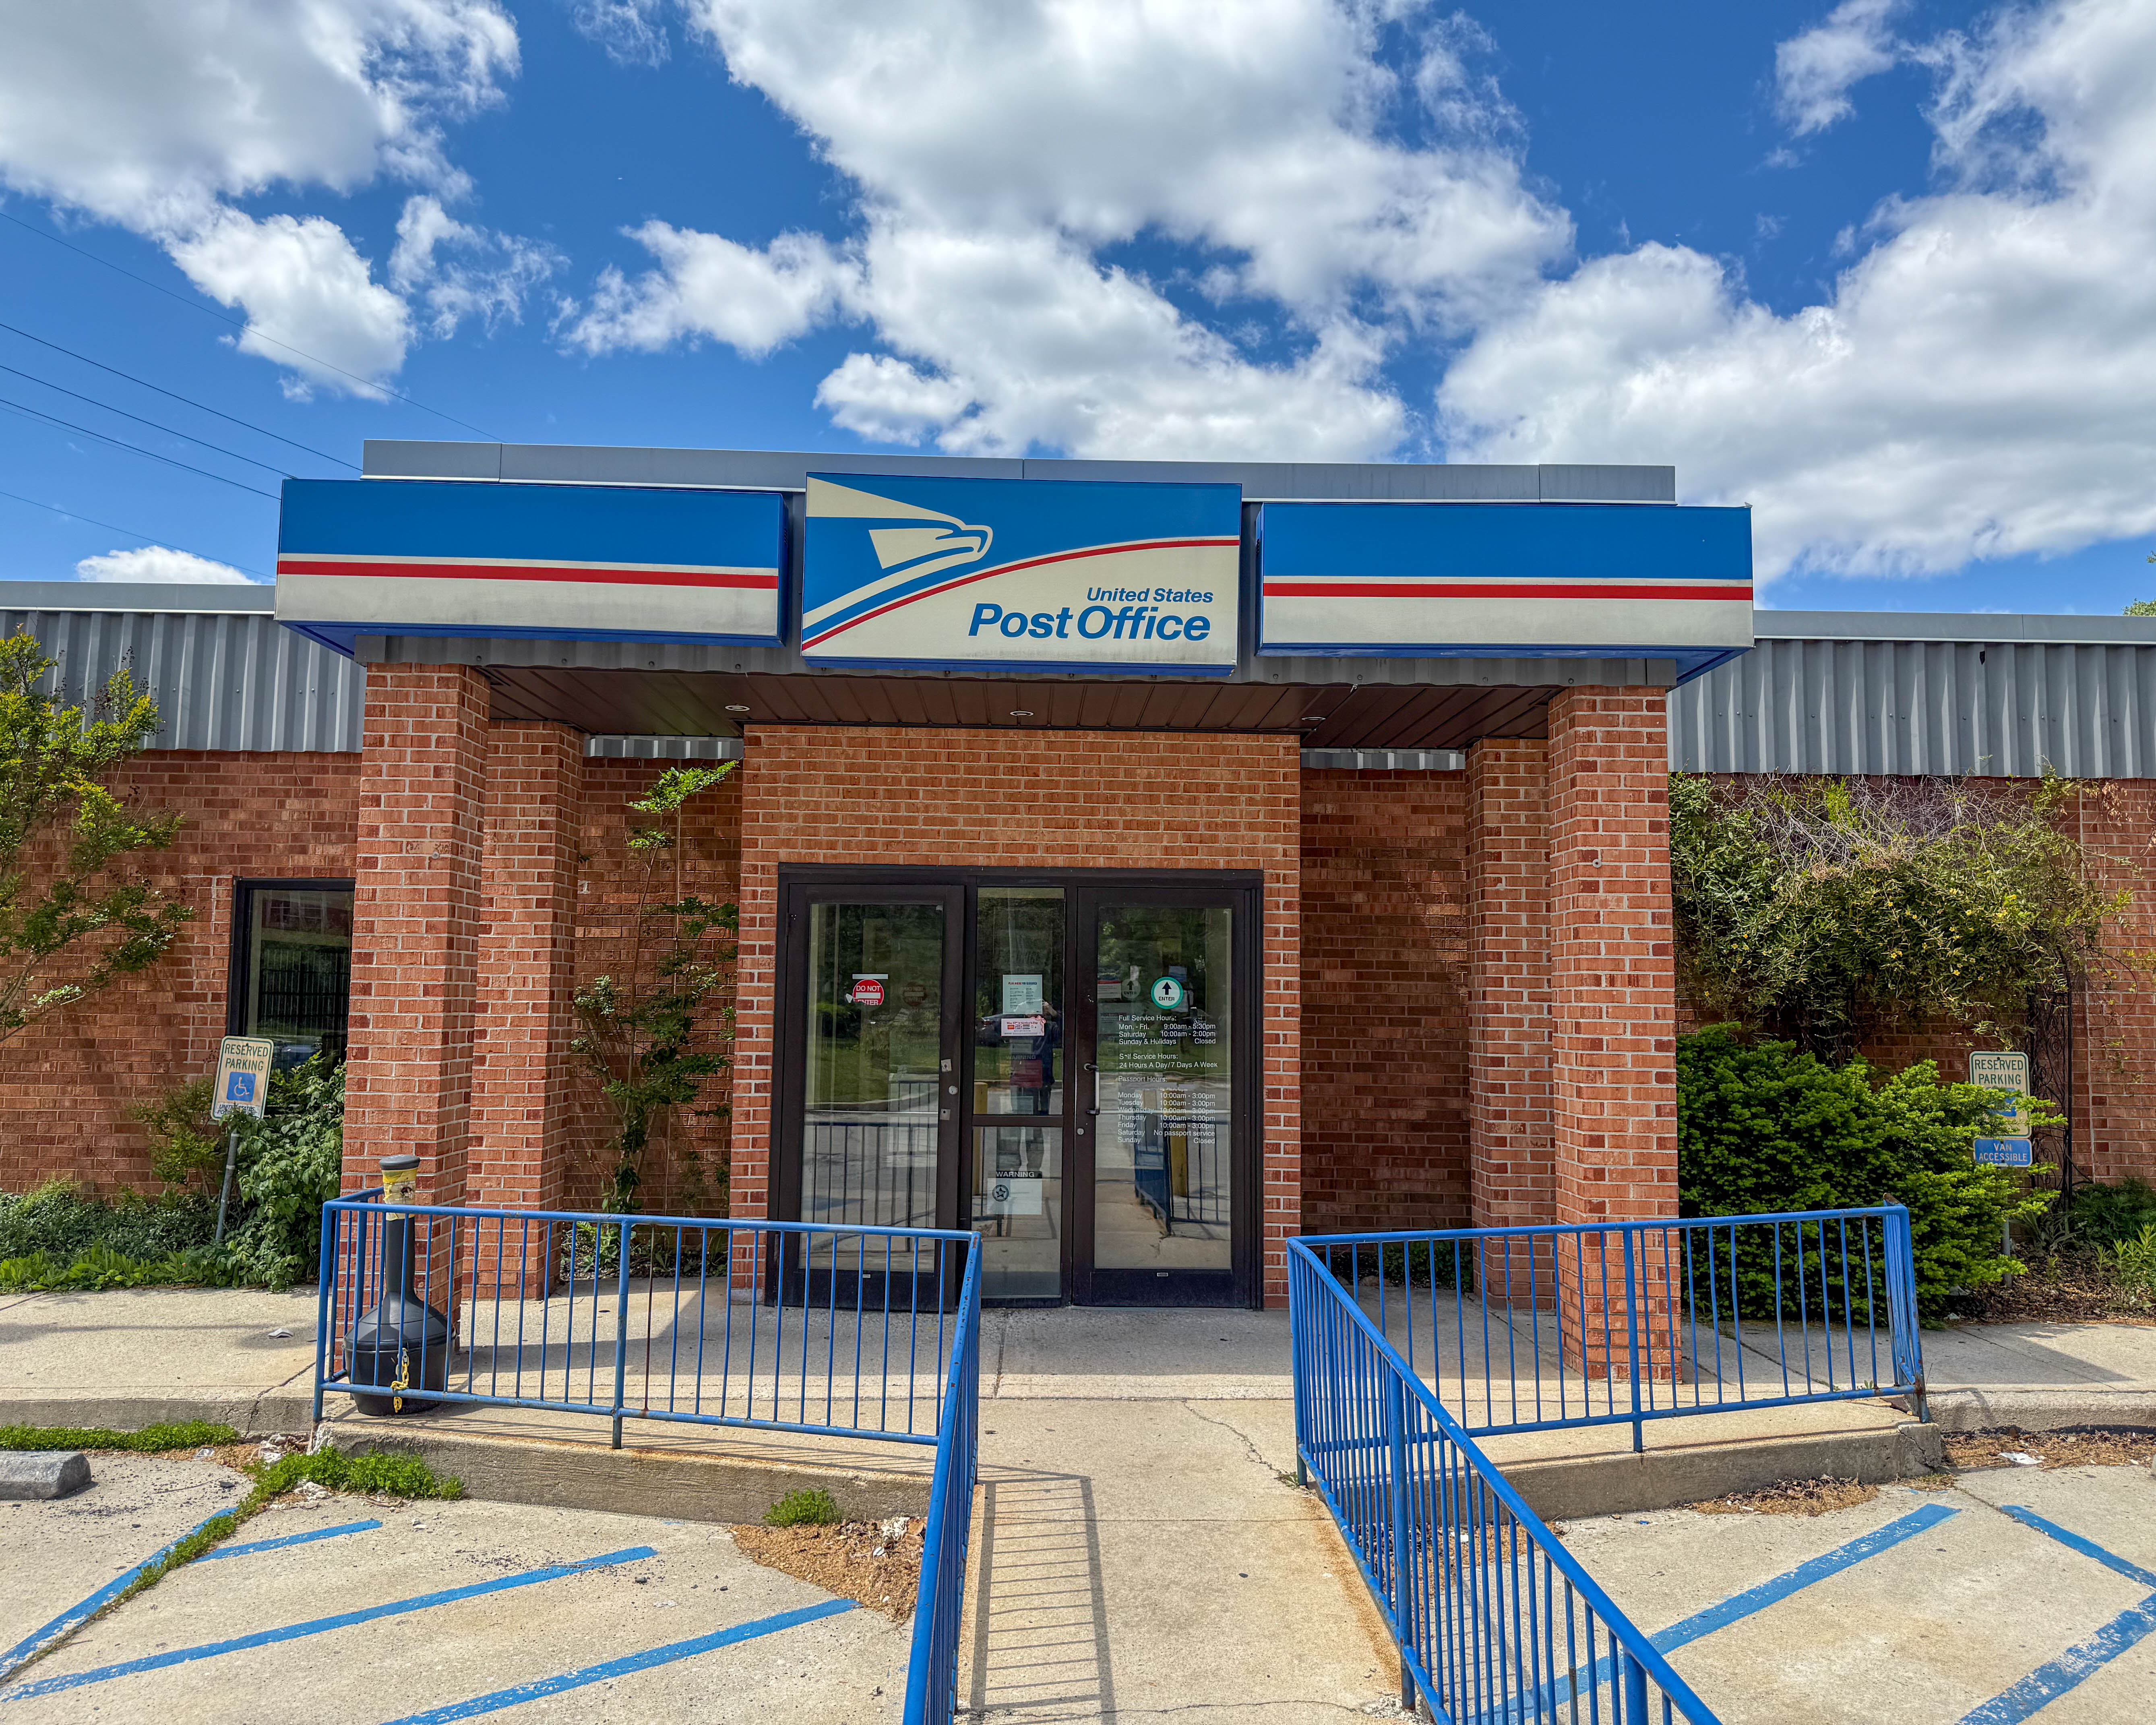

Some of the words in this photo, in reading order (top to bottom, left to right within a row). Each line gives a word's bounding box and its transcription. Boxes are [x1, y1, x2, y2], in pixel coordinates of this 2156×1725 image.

[1087, 587, 1150, 602] United
[1153, 588, 1213, 603] States
[968, 603, 1073, 639] Post
[1077, 606, 1210, 641] Office
[225, 1043, 269, 1057] RESERVED
[225, 1058, 264, 1071] PARKING
[1974, 1059, 2024, 1070] RESERVED
[1978, 1074, 2021, 1084] PARKING
[1994, 1143, 2012, 1151] VAN
[1979, 1152, 2027, 1162] ACCESSIBLE
